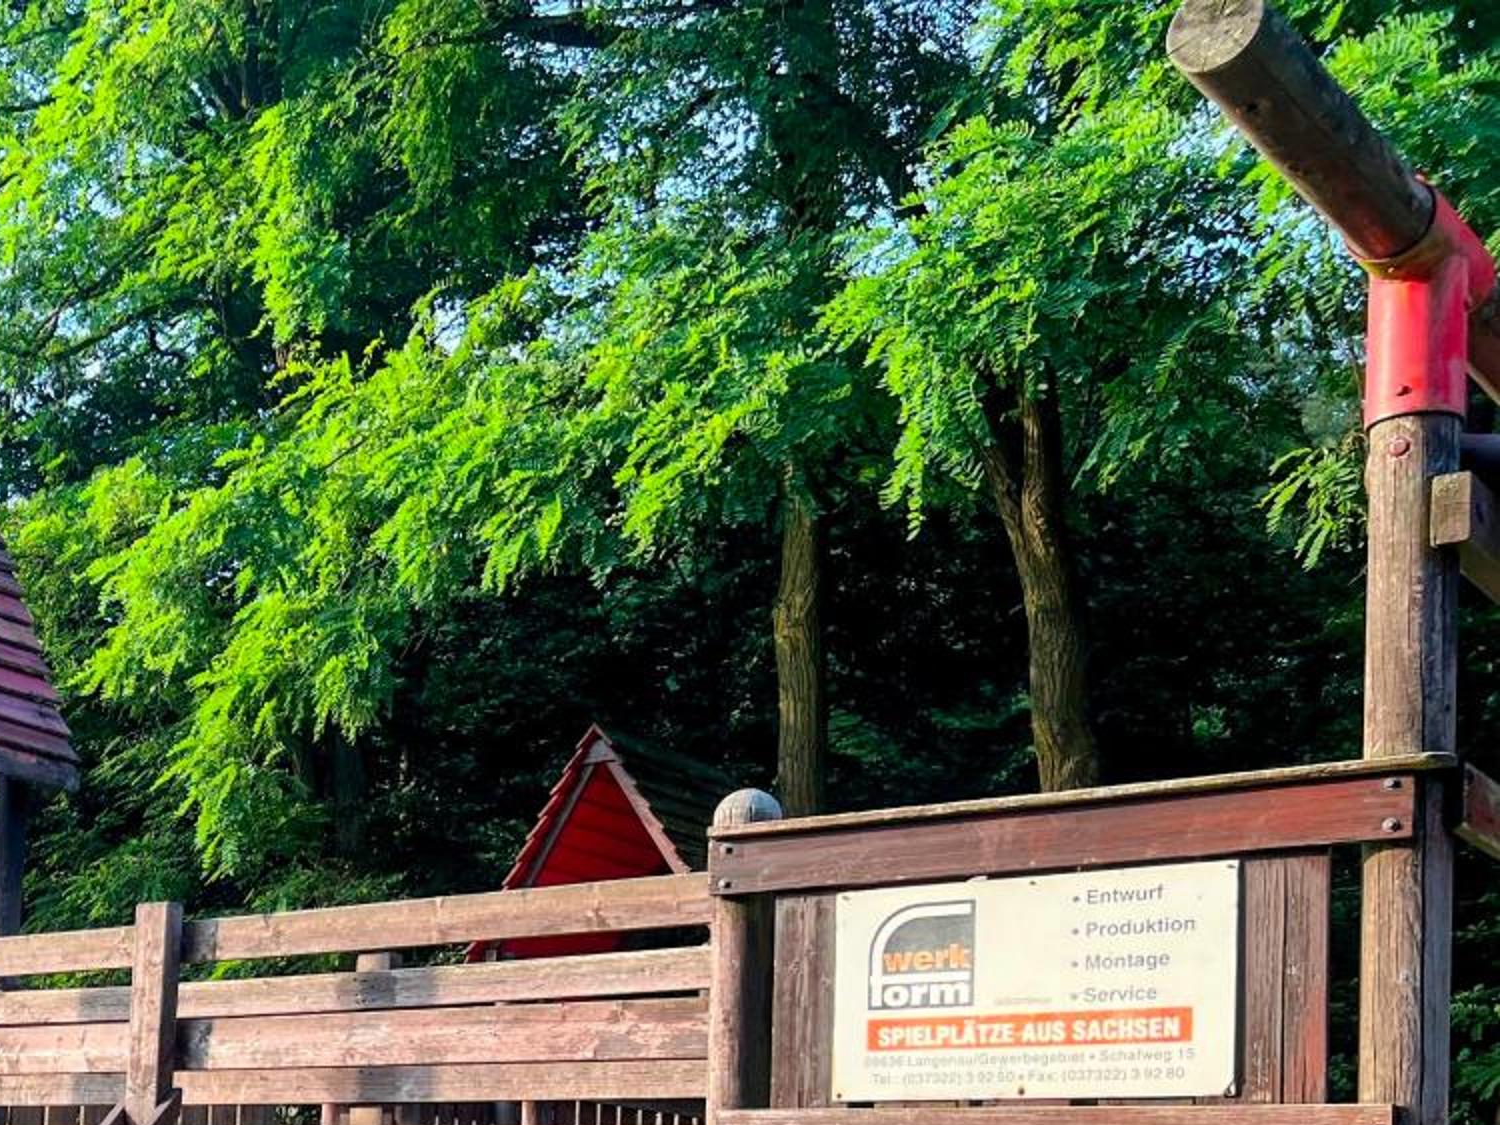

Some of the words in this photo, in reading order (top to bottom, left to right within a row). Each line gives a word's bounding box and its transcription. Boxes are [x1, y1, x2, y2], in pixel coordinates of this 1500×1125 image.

[1086, 883, 1164, 905] Entwurf
[1085, 917, 1196, 937] Produktion
[883, 943, 971, 972] werk
[1085, 952, 1170, 970] Montage
[1083, 985, 1157, 1003] Service
[878, 1019, 1013, 1047] SPIELPLÄTZE
[1022, 1020, 1065, 1042] AUS
[1071, 1016, 1180, 1041] SACHSEN
